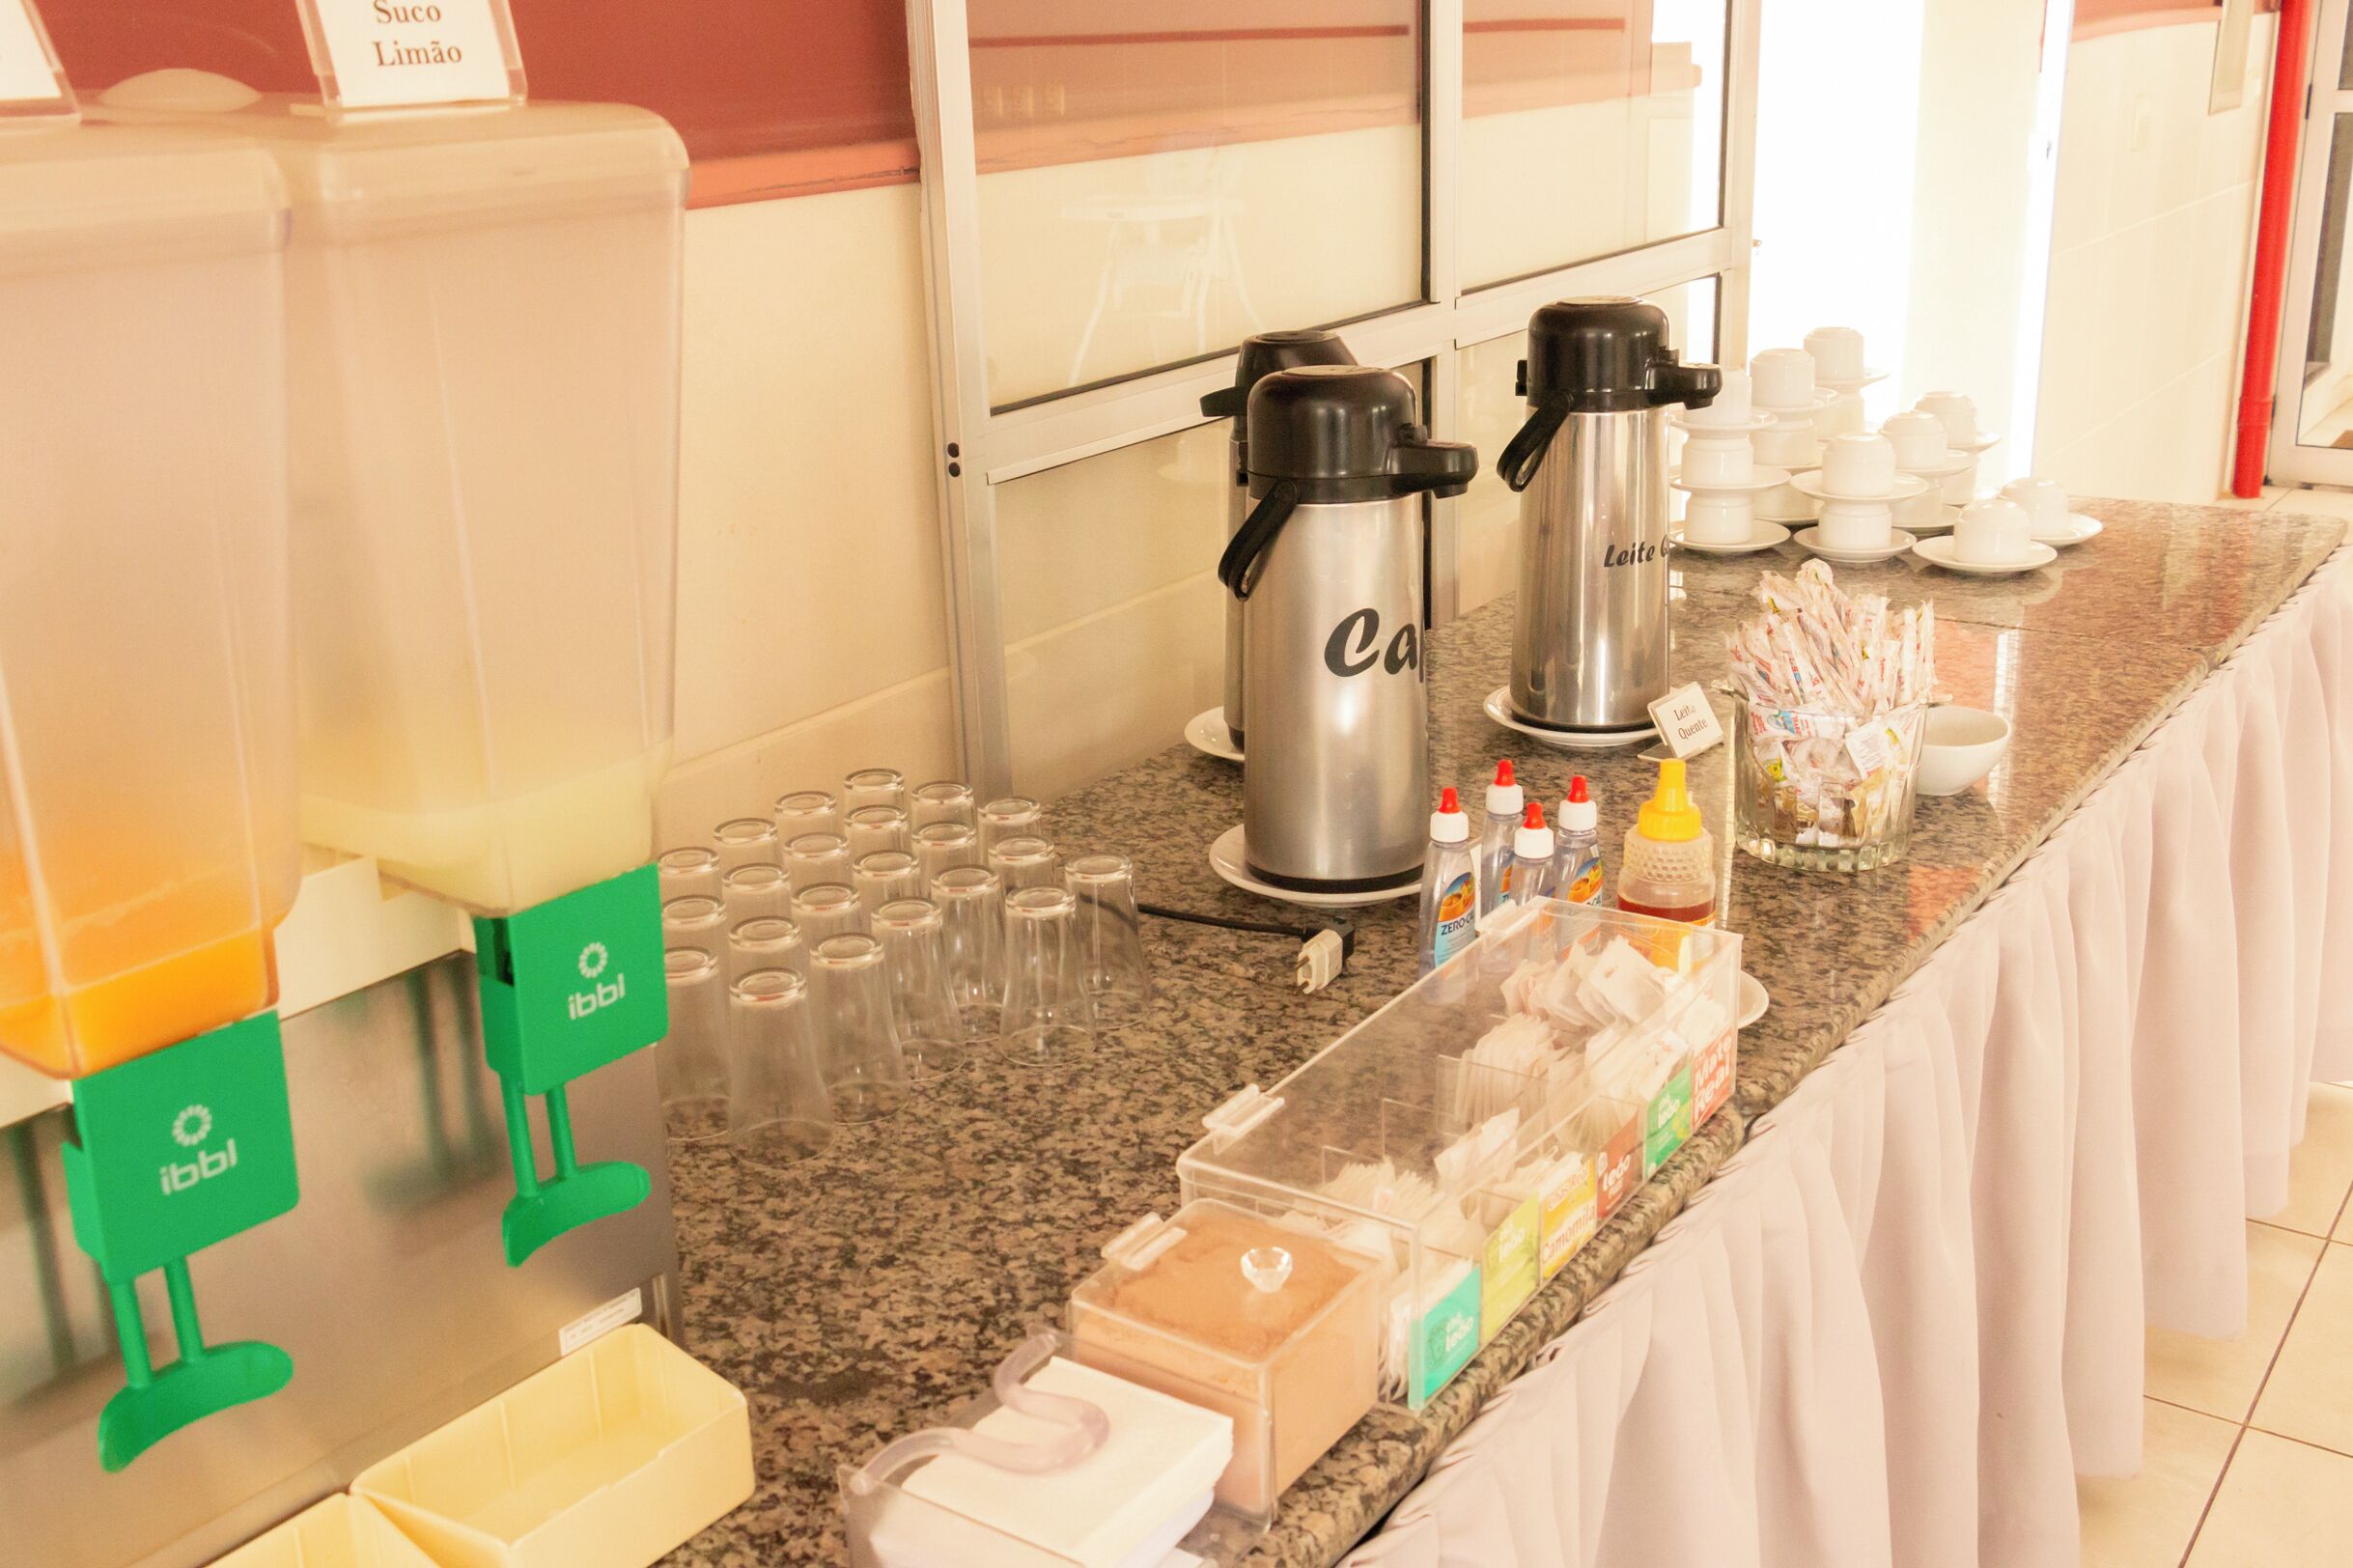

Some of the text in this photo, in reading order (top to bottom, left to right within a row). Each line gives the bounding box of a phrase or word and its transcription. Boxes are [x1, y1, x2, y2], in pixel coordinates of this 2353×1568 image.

[374, 0, 442, 24] Suco
[372, 40, 462, 67] Limão
[1603, 541, 1656, 568] Leite
[1678, 717, 1709, 741] Quente
[568, 972, 626, 1020] ibbl
[1694, 1051, 1731, 1123] Real
[159, 1137, 238, 1196] ibbl
